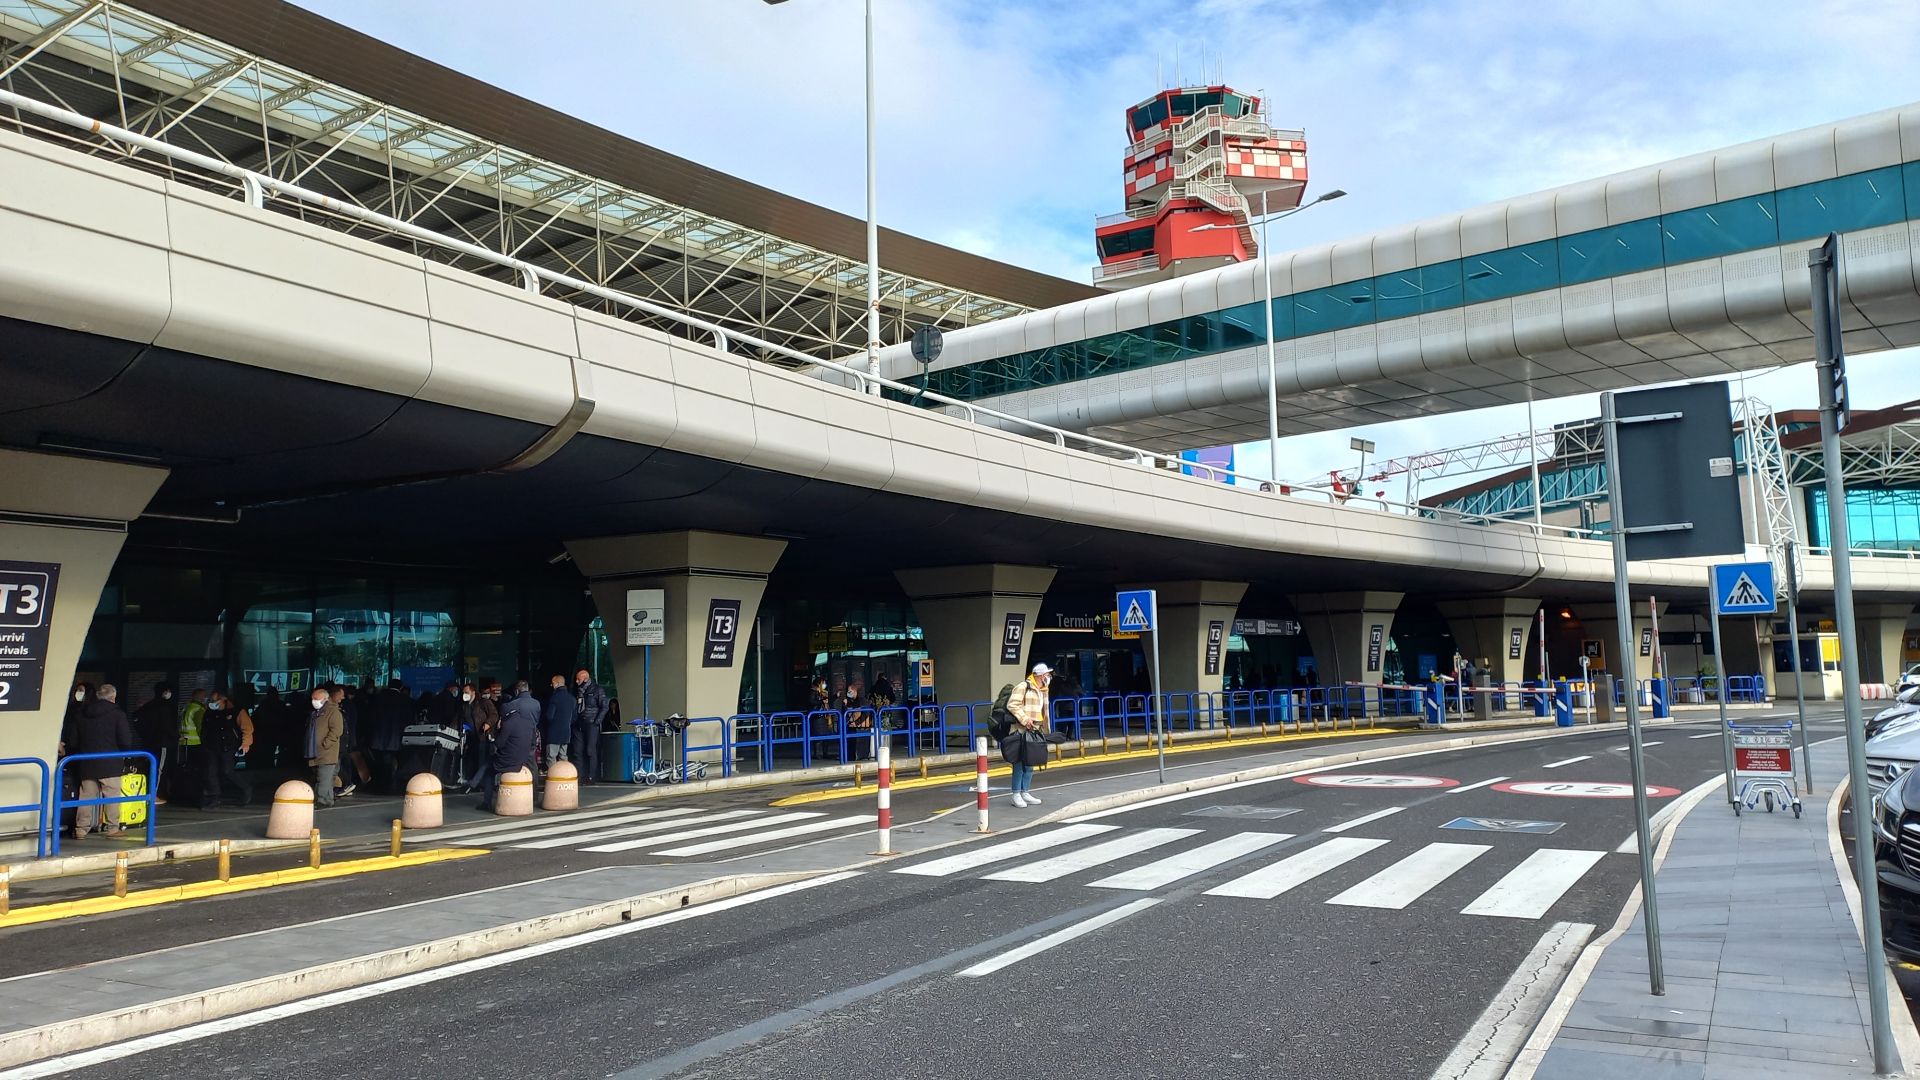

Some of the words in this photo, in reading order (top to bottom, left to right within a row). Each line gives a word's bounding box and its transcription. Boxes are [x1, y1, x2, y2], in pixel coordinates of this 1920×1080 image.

[714, 615, 733, 634] T3
[0, 632, 25, 642] rrivi
[1008, 626, 1020, 639] T3
[1211, 629, 1220, 640] T3
[1373, 632, 1381, 641] T3
[1513, 635, 1520, 645] T3
